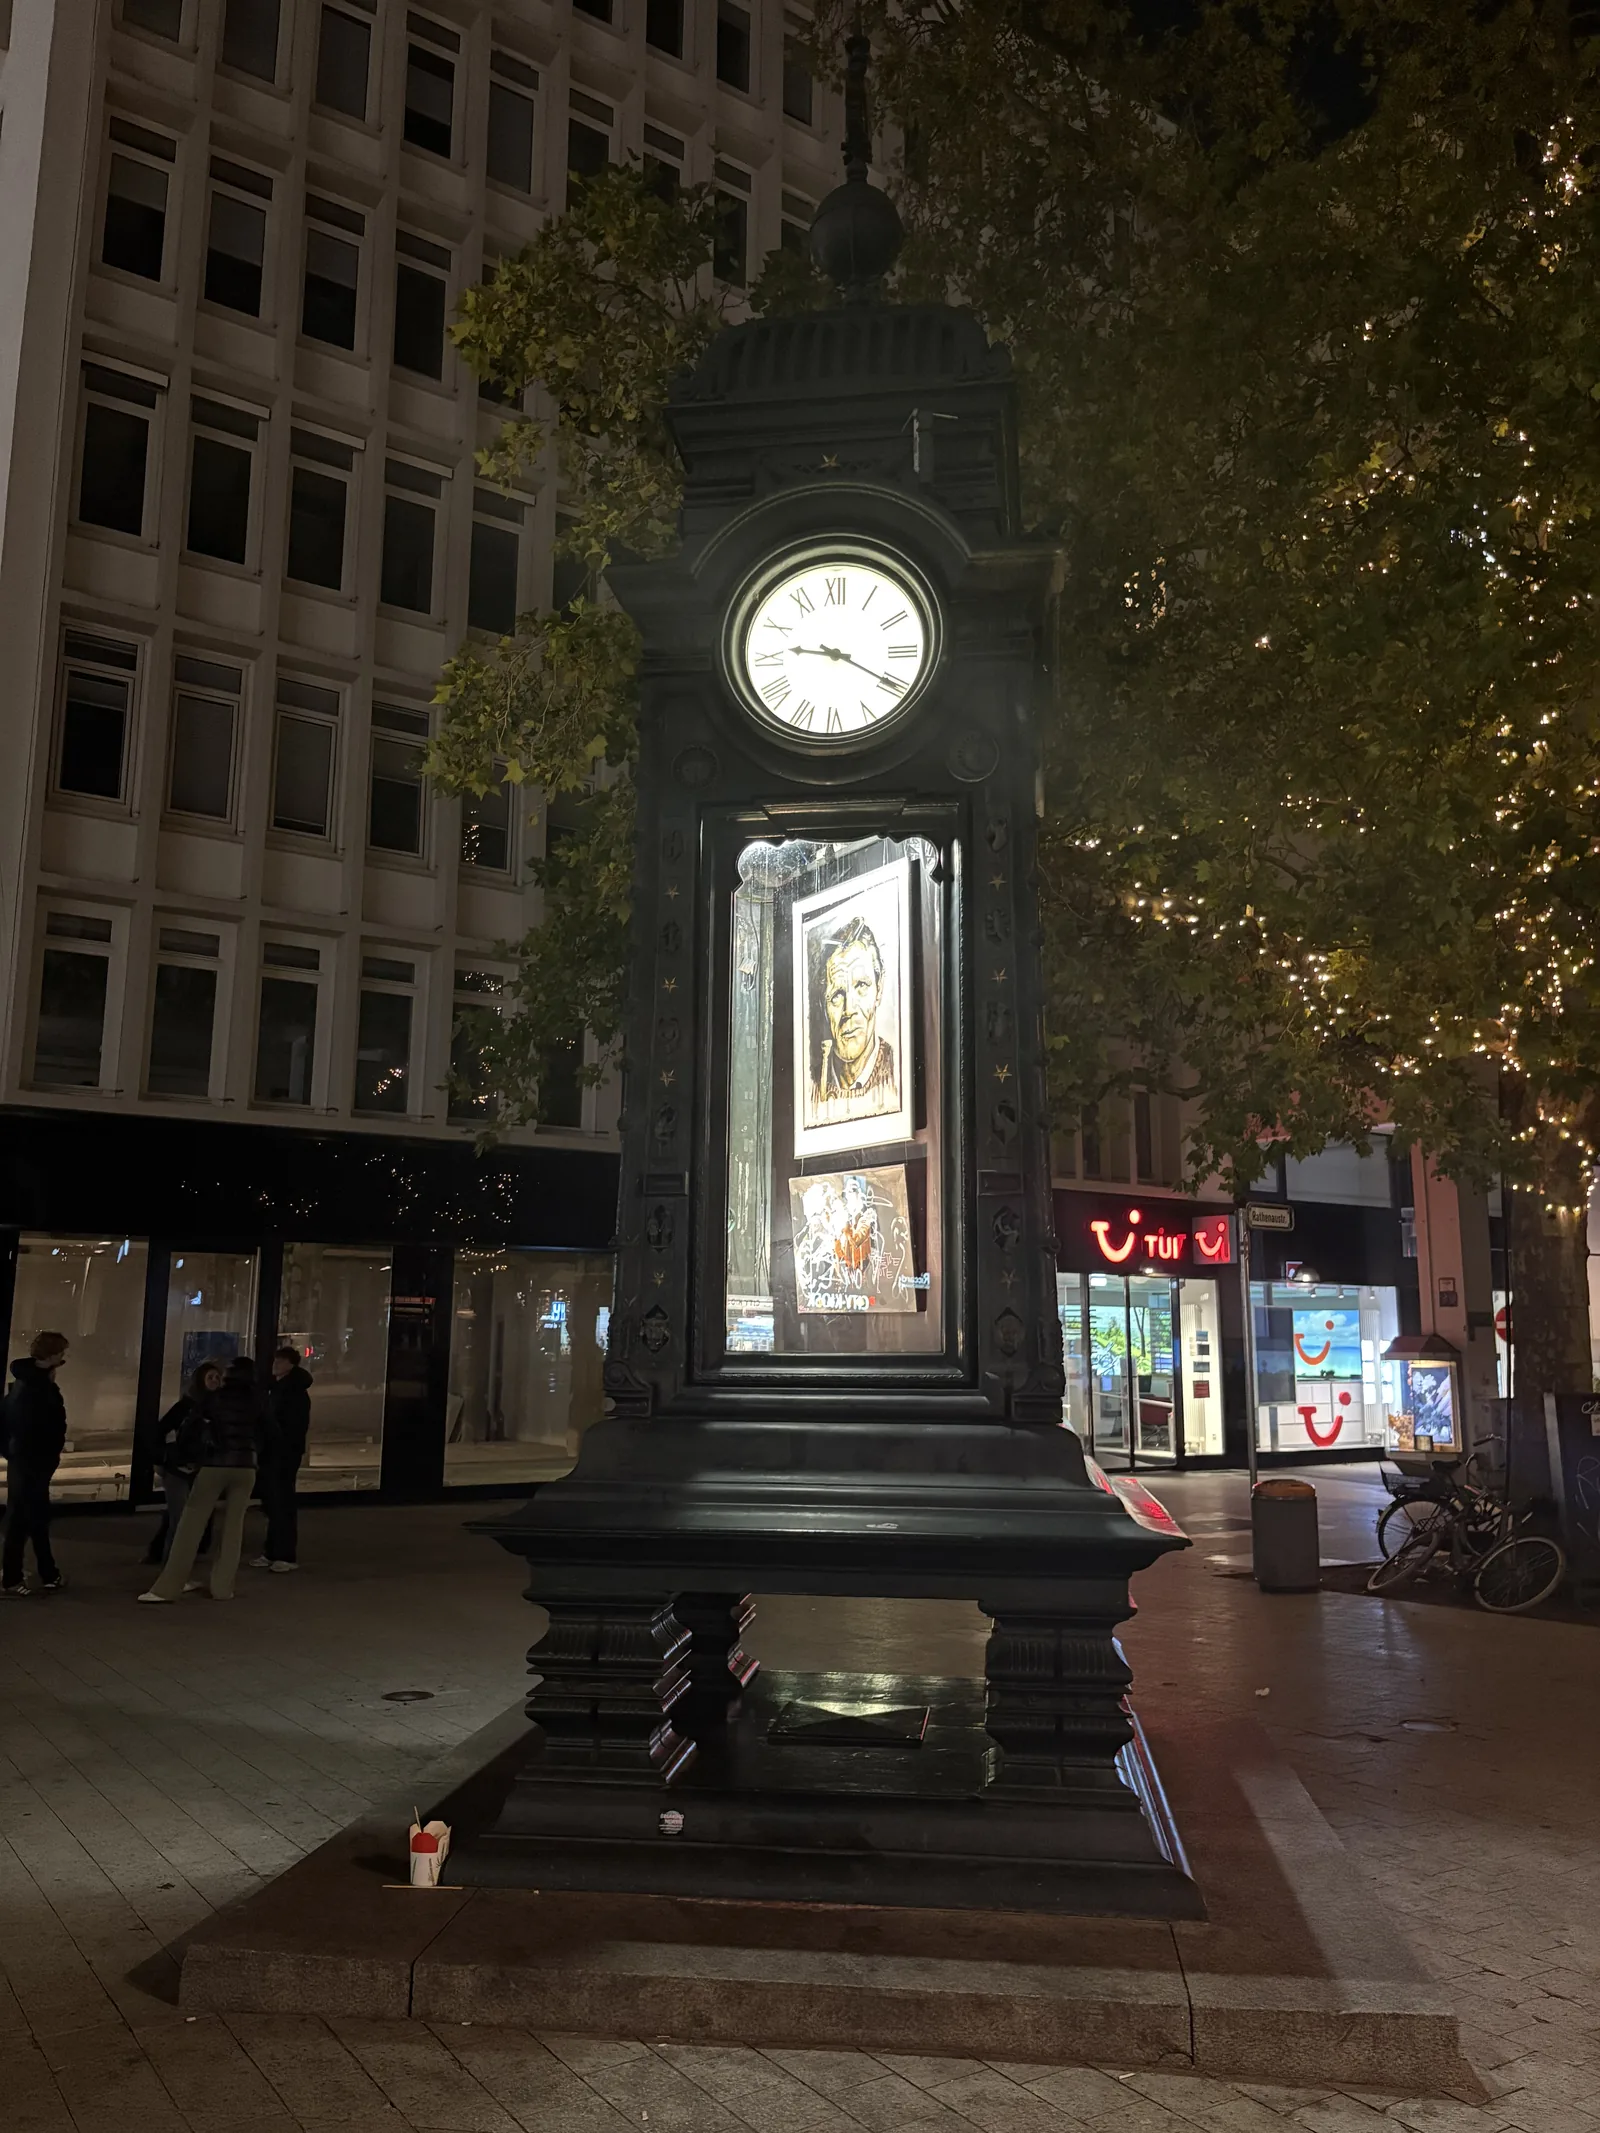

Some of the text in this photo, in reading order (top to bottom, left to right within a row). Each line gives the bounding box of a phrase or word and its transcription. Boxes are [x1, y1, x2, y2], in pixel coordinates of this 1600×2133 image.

[824, 577, 846, 607] XII
[1251, 1210, 1287, 1224] Rathenaustr.
[1144, 1233, 1179, 1260] TUI
